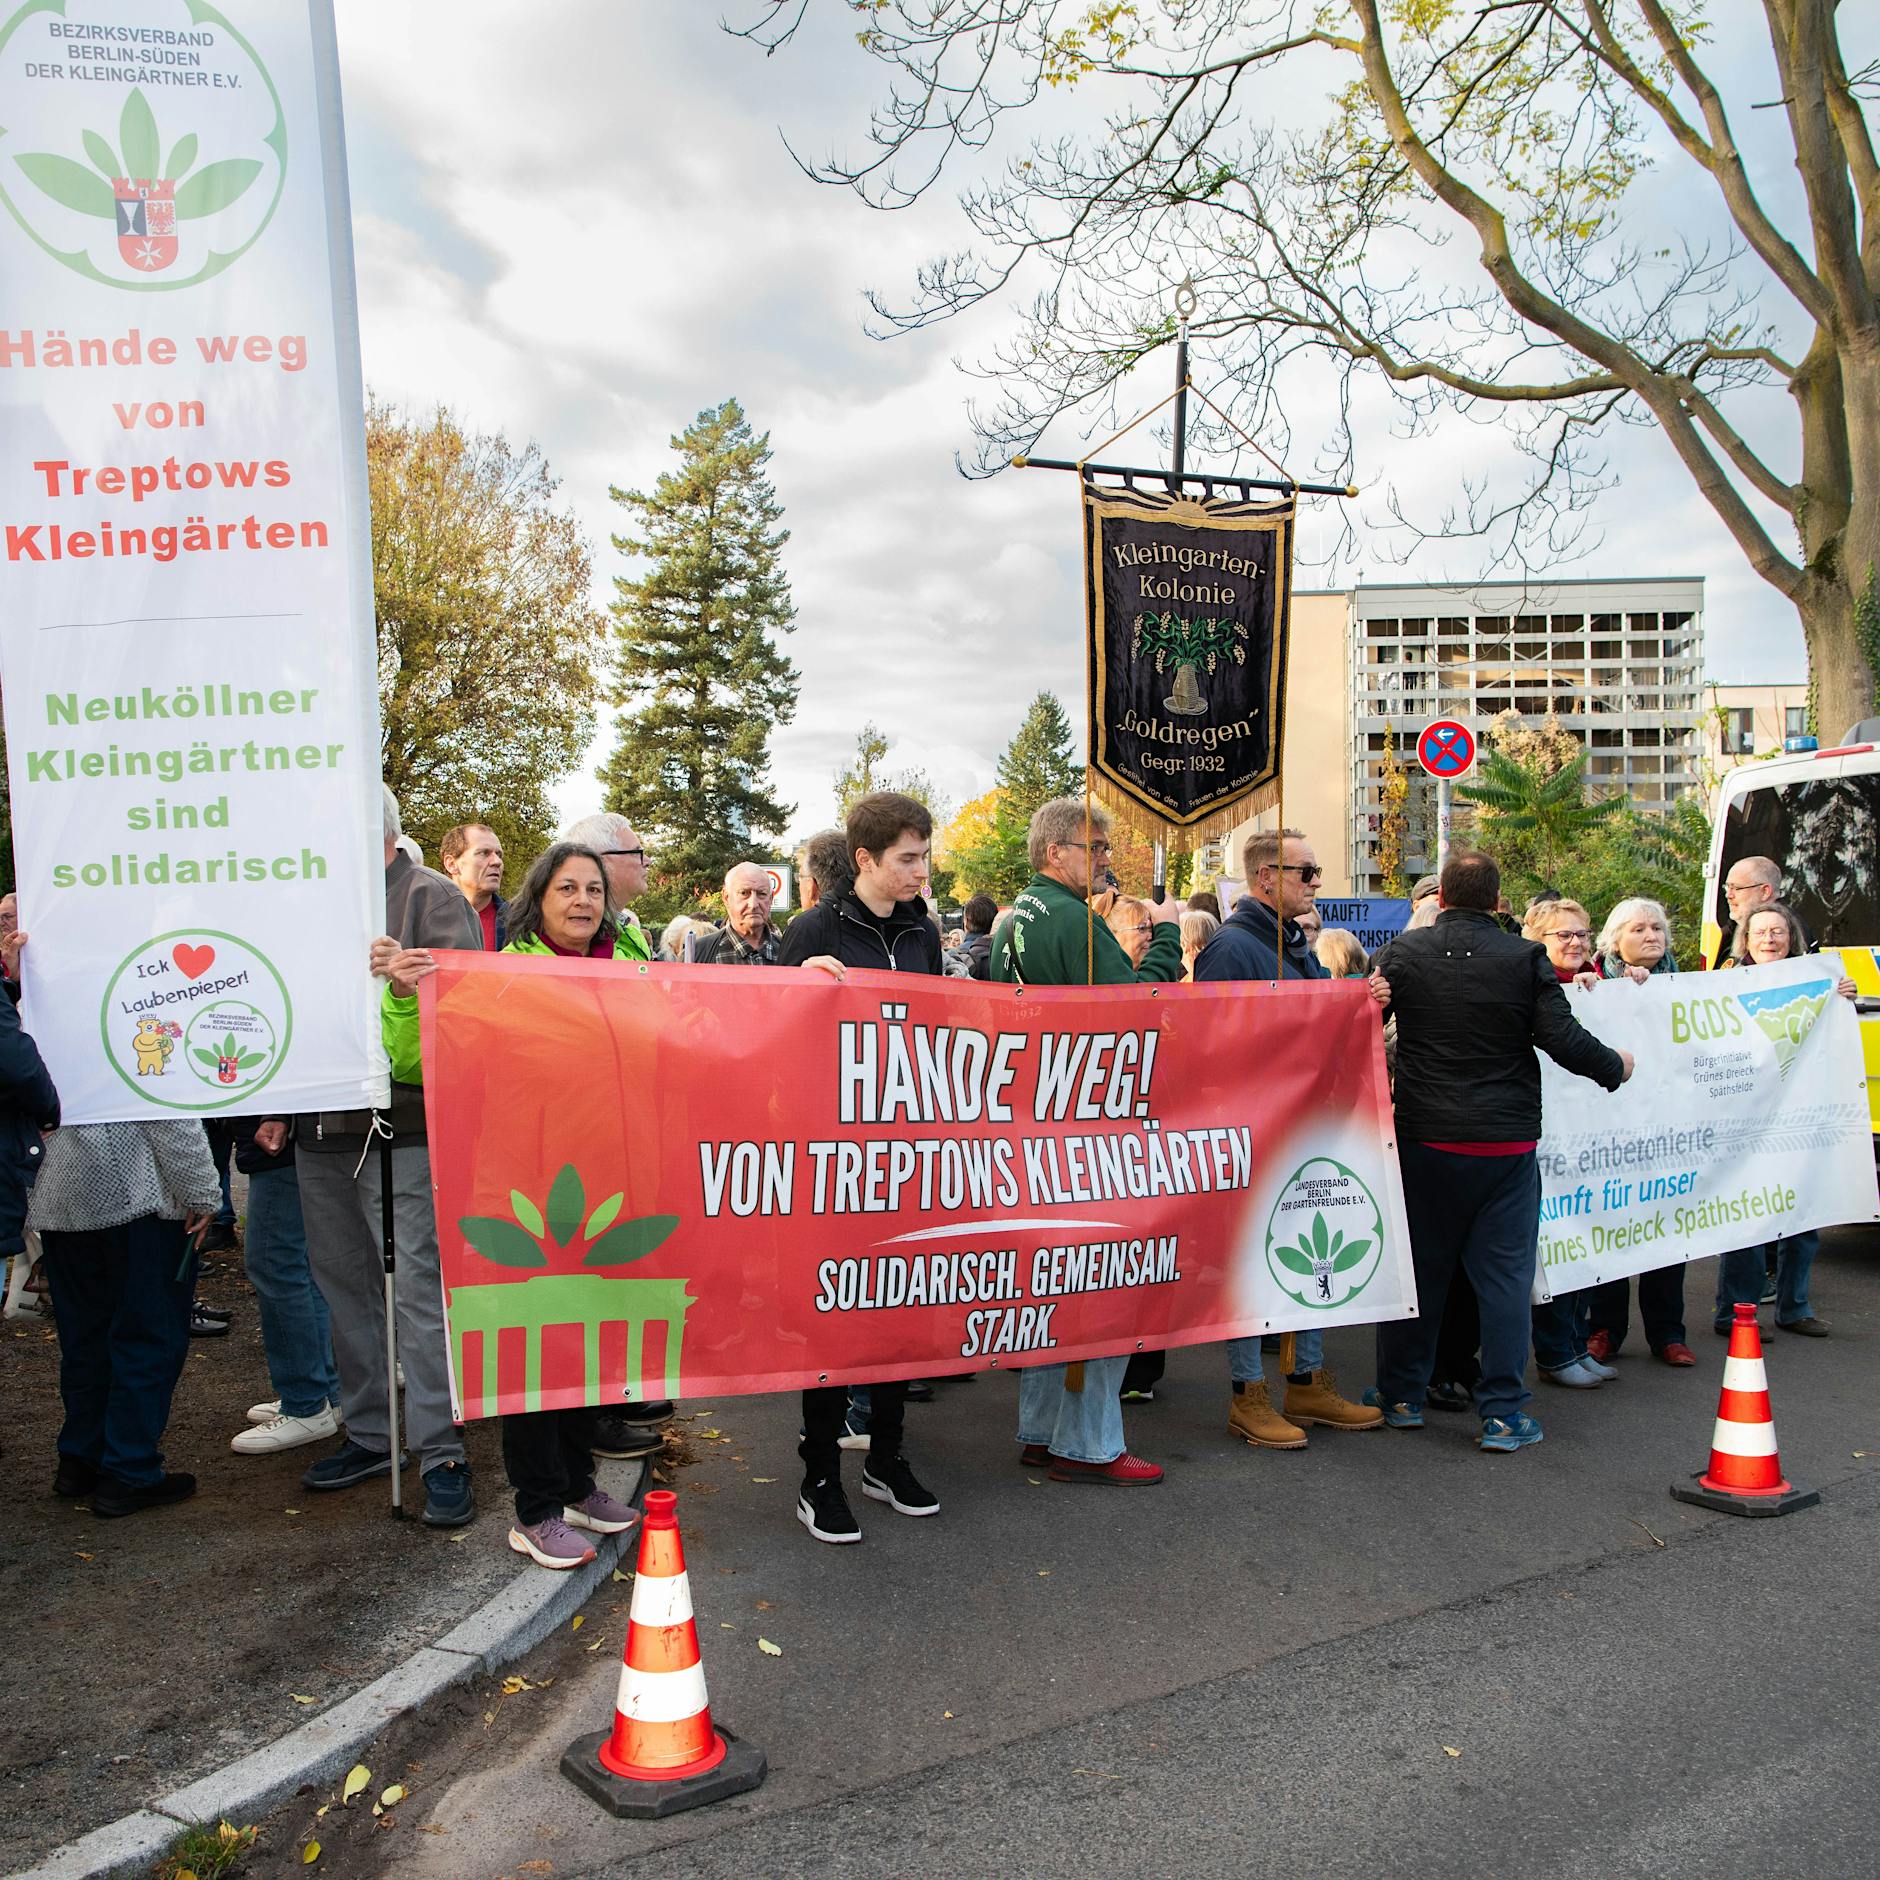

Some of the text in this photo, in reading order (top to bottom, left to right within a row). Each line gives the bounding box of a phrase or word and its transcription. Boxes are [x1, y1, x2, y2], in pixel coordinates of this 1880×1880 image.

[49, 22, 214, 47] BEZIRKSVERBAND
[68, 44, 201, 66] BERLIN-SÜDEN
[25, 63, 243, 89] DER KLEINGÄRTNER E.V.
[0, 329, 308, 372] Hände weg
[113, 400, 205, 430] von
[34, 456, 291, 502] Treptows
[6, 515, 329, 562] Kleingärten
[1113, 542, 1266, 580] Kleingarten-
[1139, 575, 1236, 605] Kolonie
[45, 684, 319, 726] Neuköllner
[27, 740, 345, 782] Kleingärtner
[1141, 752, 1225, 775] Gegr. 1932
[1147, 785, 1162, 799] von
[1163, 795, 1179, 808] den
[1187, 791, 1215, 808] Frauen
[1215, 785, 1229, 796] der
[1230, 769, 1259, 788] Kolonie
[127, 796, 230, 831] sind
[52, 848, 328, 889] solidarisch
[137, 960, 170, 978] Ick
[122, 970, 249, 1014] Laubenpieper!
[208, 1013, 257, 1021] BEZIRKSVERBAND
[1671, 995, 1743, 1044] BGDS
[838, 1002, 1160, 1125] HÄNDE WEG!
[1693, 1051, 1753, 1069] Bürgerinitiative
[1693, 1065, 1755, 1084] Grünes Dreieck
[1709, 1081, 1754, 1100] Späthsfelde
[699, 1119, 1254, 1218] VON TREPTOWS KLEINGÄRTEN
[1577, 1126, 1715, 1174] einbetonierte
[1281, 1195, 1367, 1212] DER GARTENFREUNDE E.V.
[1295, 1178, 1349, 1191] LANDESVERBAND
[1307, 1188, 1332, 1199] BERLIN
[1602, 1177, 1633, 1211] für
[1638, 1169, 1698, 1203] unser
[1591, 1209, 1666, 1255] Dreieck
[1673, 1183, 1796, 1239] Späthsfelde
[814, 1235, 1181, 1313] SOLIDARISCH. GEMEINSAM.
[960, 1303, 1058, 1358] STARK.
